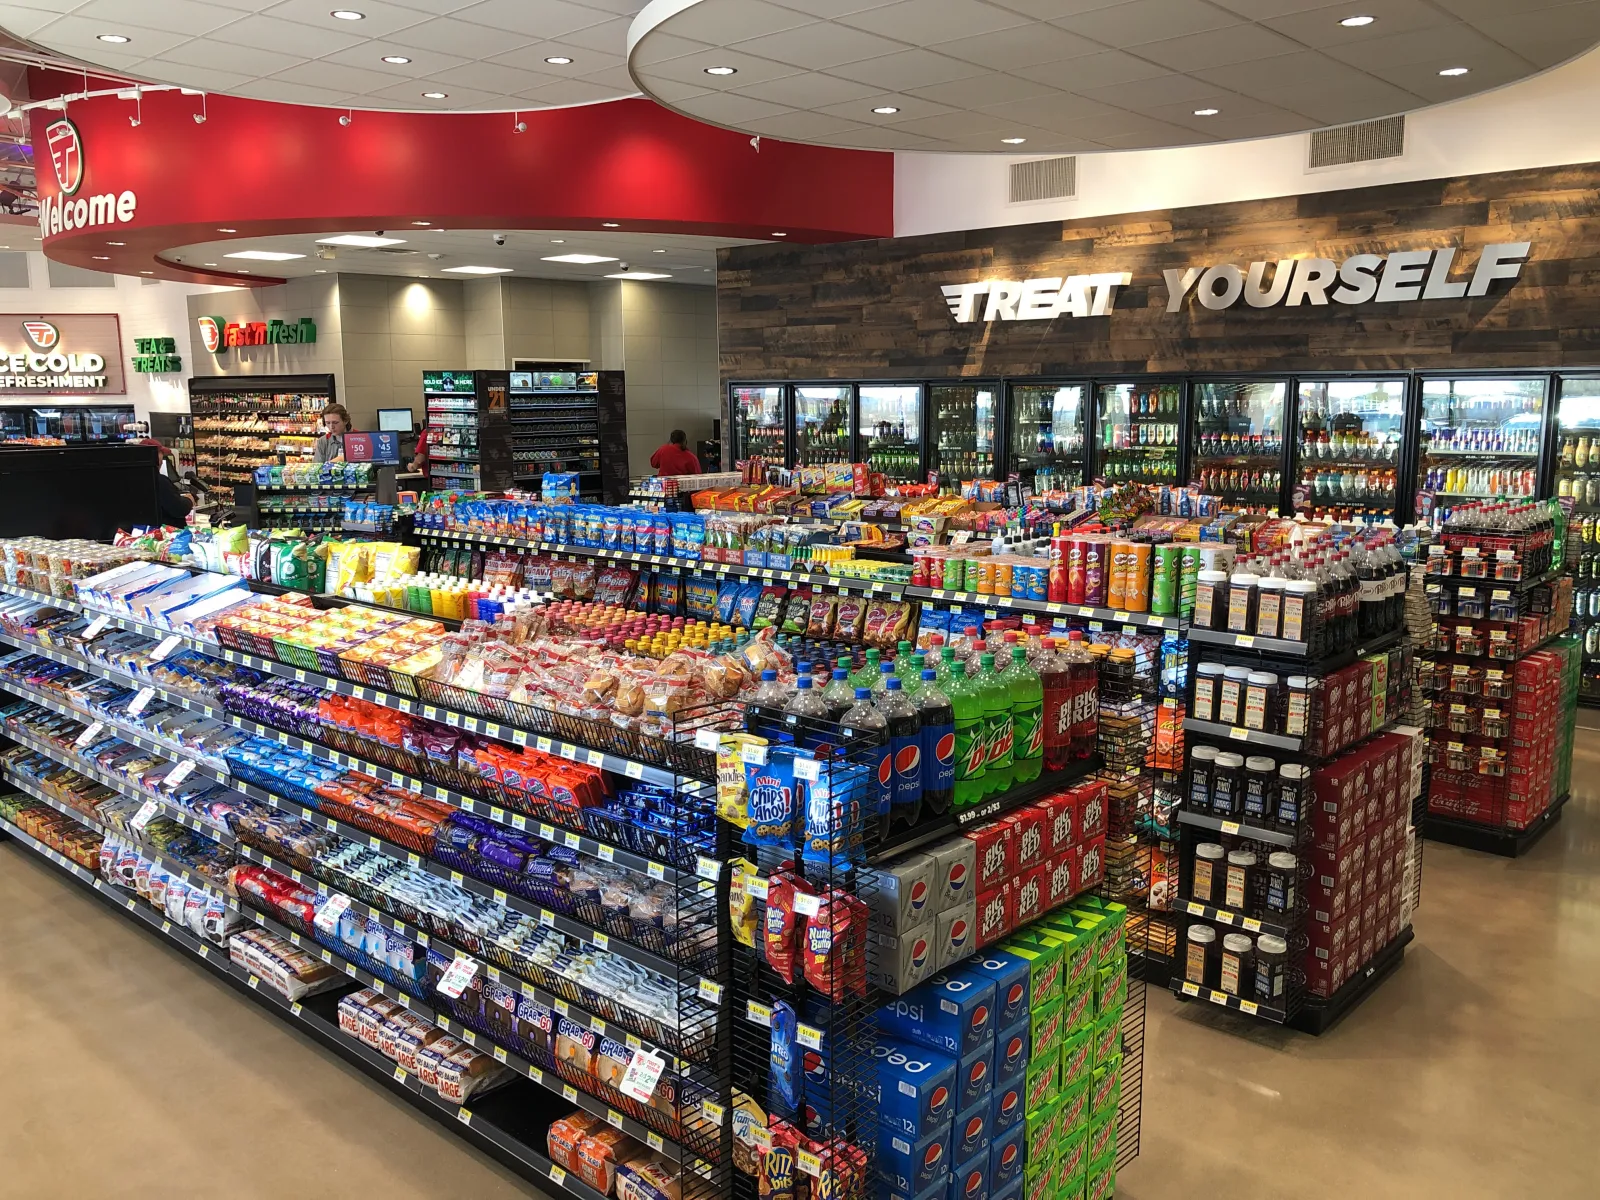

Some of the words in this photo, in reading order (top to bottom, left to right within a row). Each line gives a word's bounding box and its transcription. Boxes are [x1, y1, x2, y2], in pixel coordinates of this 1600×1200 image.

[38, 190, 137, 239] Welcome
[940, 271, 1133, 324] TREAT
[1162, 241, 1531, 314] YOURSELF
[266, 320, 308, 345] fresh
[133, 338, 158, 355] TEA
[158, 338, 167, 354] &
[29, 353, 105, 373] COLD
[131, 356, 173, 373] TREATS
[488, 391, 506, 410] 21
[378, 443, 391, 451] $45
[1074, 685, 1096, 711] BIG
[1060, 699, 1071, 719] BI
[1072, 699, 1098, 724] RED
[1058, 715, 1071, 735] RE
[756, 776, 781, 788] Mini
[1100, 786, 1107, 795] 12
[750, 786, 784, 809] Chips
[1085, 794, 1100, 818] BIG
[959, 810, 976, 824] $1.99
[980, 808, 987, 816] or
[1046, 807, 1054, 817] 12
[1054, 806, 1070, 832] BIG
[1003, 828, 1011, 839] 12
[1014, 822, 1022, 833] 12
[1021, 821, 1038, 848] BIG
[1052, 820, 1071, 847] RED
[985, 838, 1003, 866] BIG
[1020, 835, 1041, 863] RED
[1082, 844, 1098, 868] BIG
[1045, 860, 1052, 871] 12
[1052, 859, 1068, 885] BIG
[1081, 857, 1100, 883] RED
[1002, 884, 1010, 895] 12
[1012, 876, 1020, 888] 12
[1020, 875, 1037, 903] BIG
[1050, 873, 1070, 900] RED
[985, 893, 1002, 922] BIG
[1019, 889, 1039, 918] RED
[809, 927, 831, 940] Nutte
[471, 976, 483, 992] GO
[883, 973, 894, 986] 12
[482, 984, 503, 1001] GRAB
[504, 994, 516, 1012] GO
[517, 1003, 538, 1021] GRAB
[540, 1015, 552, 1033] GO
[558, 1019, 581, 1039] GRAB
[581, 1032, 595, 1050] GO
[943, 1035, 956, 1050] 12
[600, 1037, 624, 1057] GRAB
[398, 1051, 418, 1070] ARGE
[659, 1083, 675, 1102] GO
[902, 1118, 914, 1133] 12
[764, 1149, 795, 1179] RITZ
[770, 1176, 794, 1191] bits
[896, 1174, 908, 1190] 12
